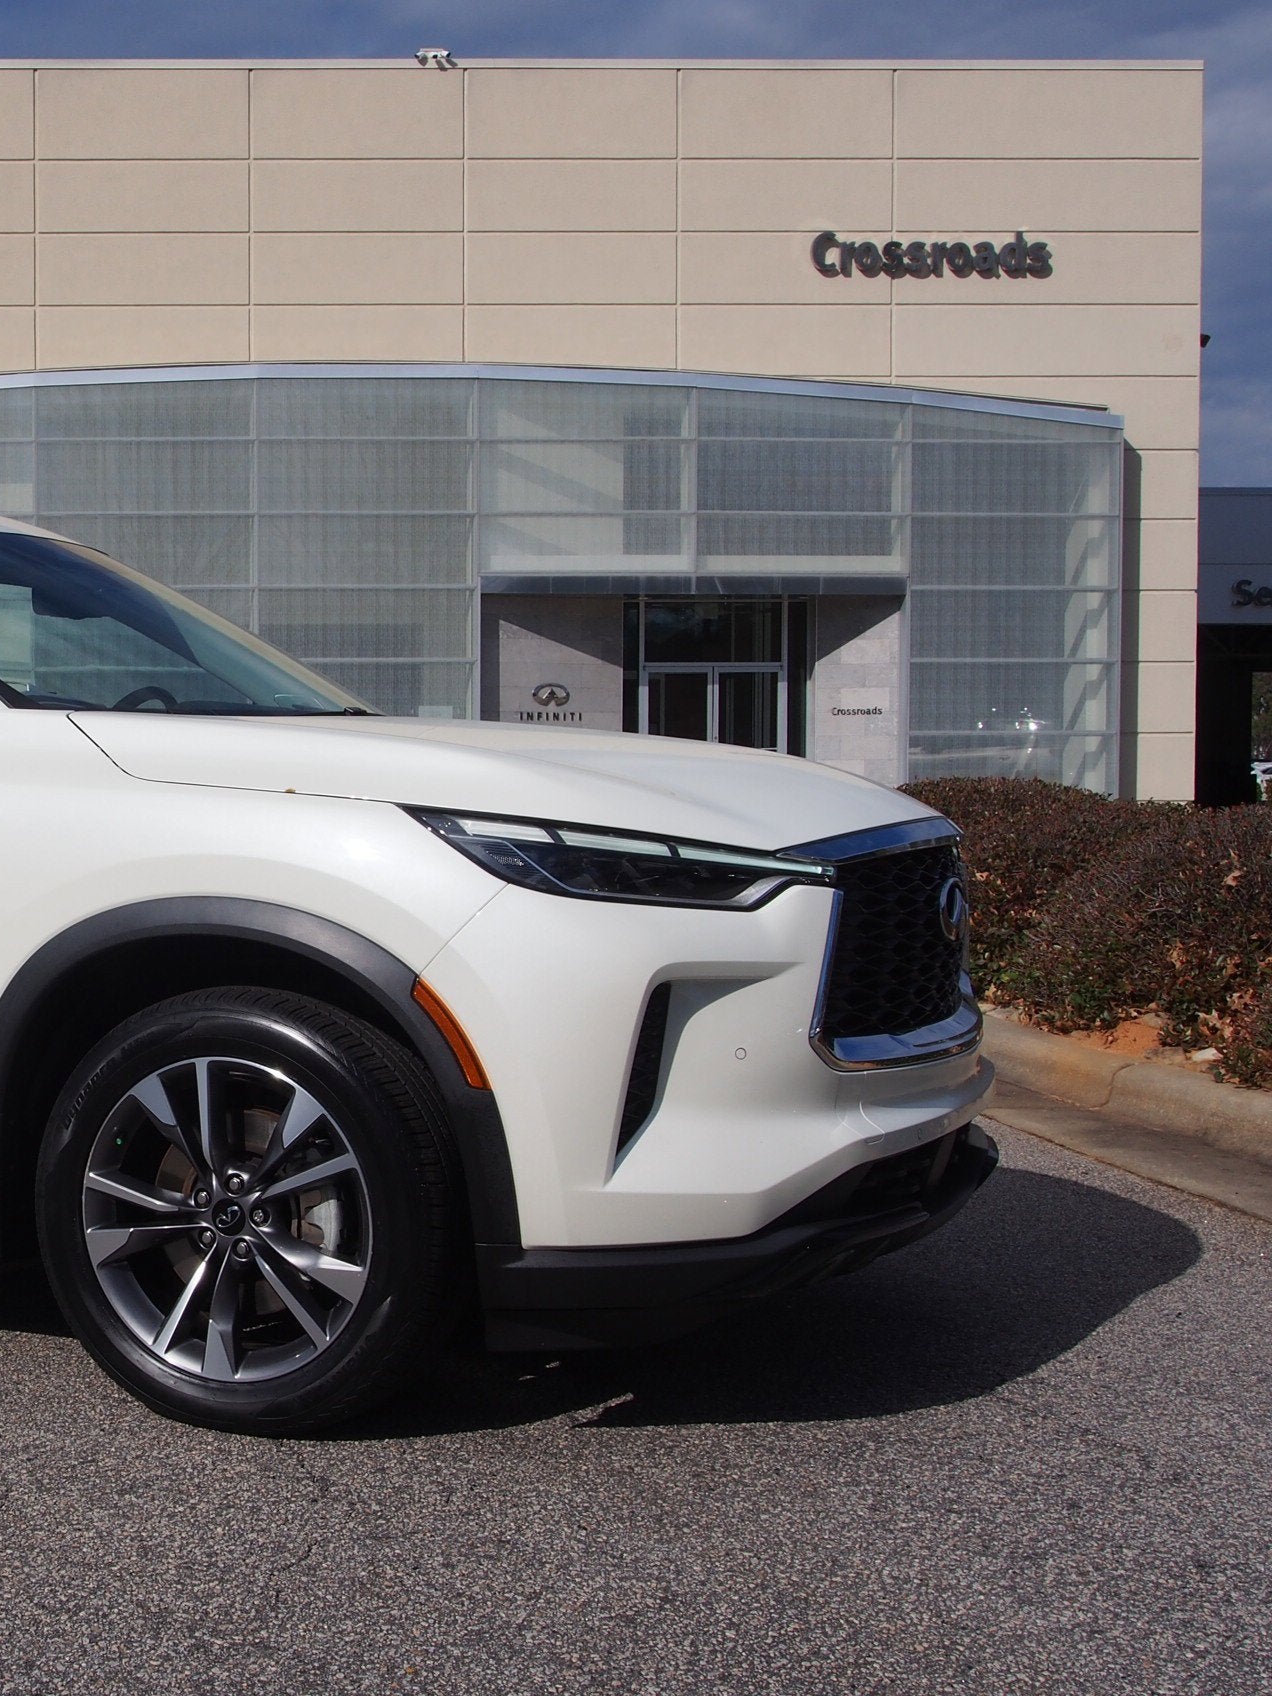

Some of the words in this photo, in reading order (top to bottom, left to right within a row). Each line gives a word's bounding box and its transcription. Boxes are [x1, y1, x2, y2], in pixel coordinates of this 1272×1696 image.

[811, 231, 1051, 278] Crossroads
[519, 711, 583, 722] INFINITI
[832, 706, 883, 716] Crossroads
